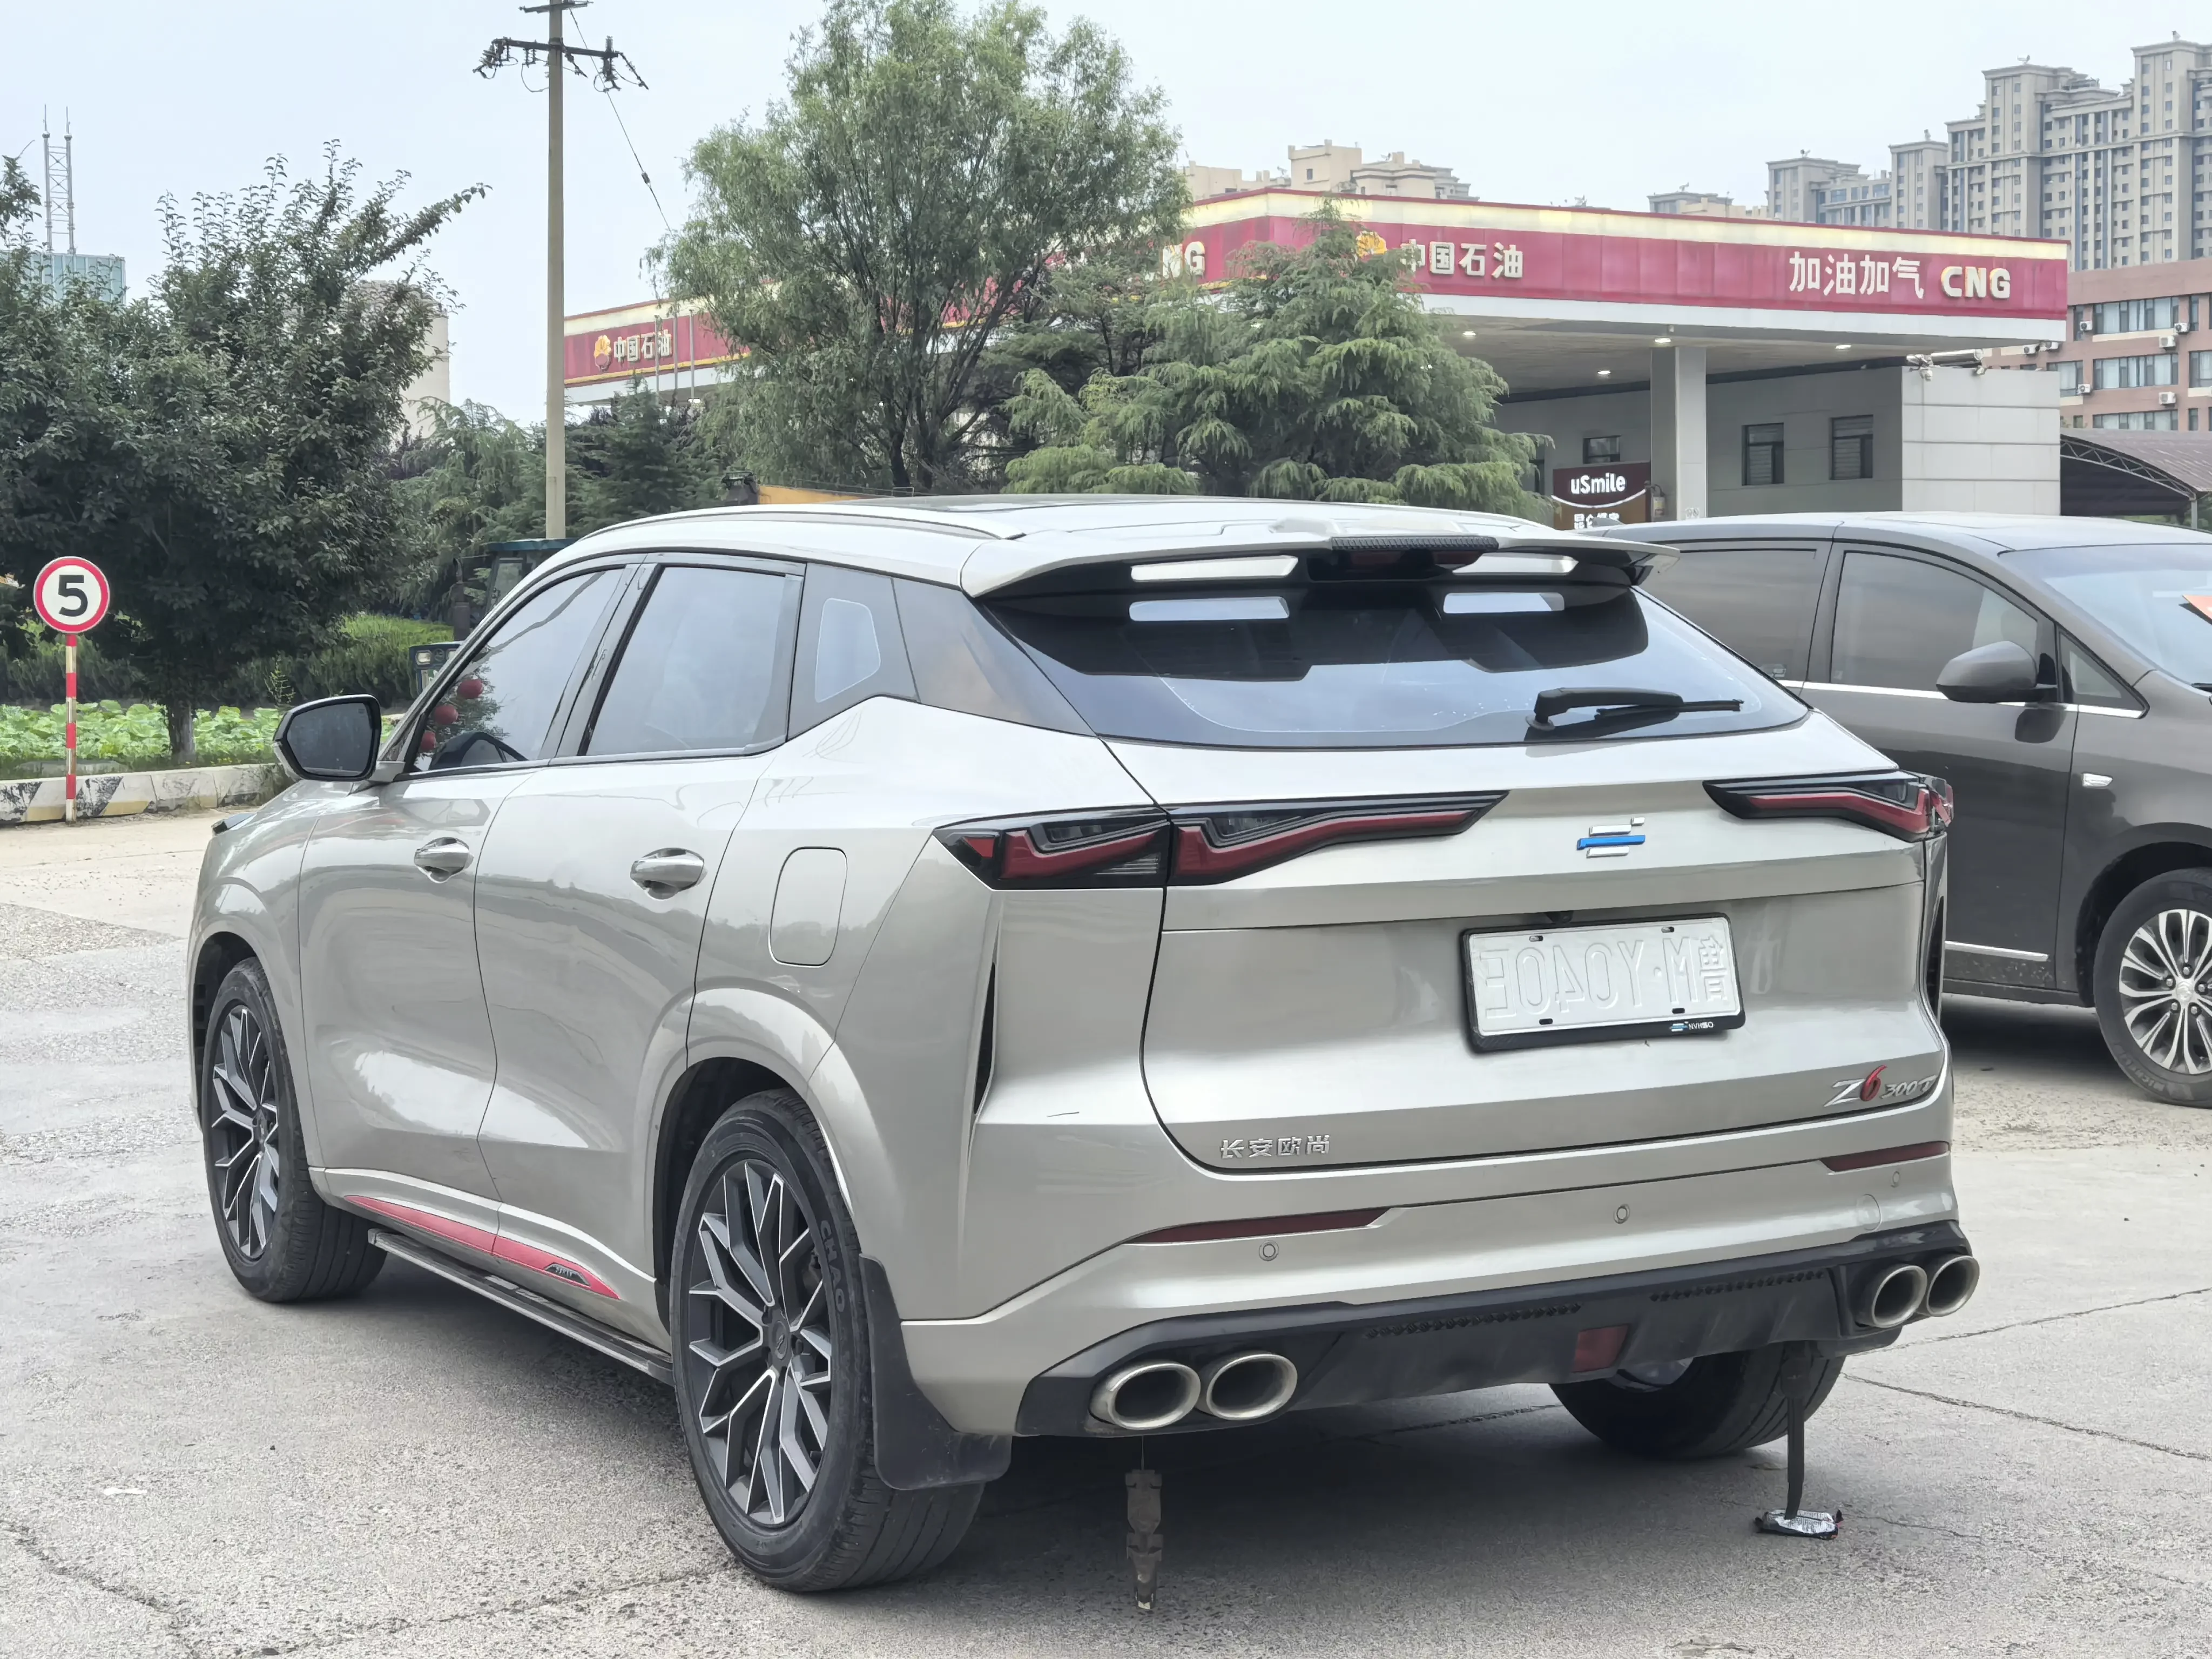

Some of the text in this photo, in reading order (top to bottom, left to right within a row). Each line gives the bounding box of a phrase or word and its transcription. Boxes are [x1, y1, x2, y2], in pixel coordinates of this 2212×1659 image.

[1144, 241, 1205, 279] NG
[1400, 239, 1523, 278] 中国石油
[1789, 251, 2011, 299] 加油加气 CNG
[613, 329, 671, 363] 中国石油
[1570, 473, 1626, 494] uSmile
[58, 575, 88, 617] 5
[1823, 1064, 1937, 1107] Z6 300T
[1220, 1135, 1330, 1159] 长安欧尚
